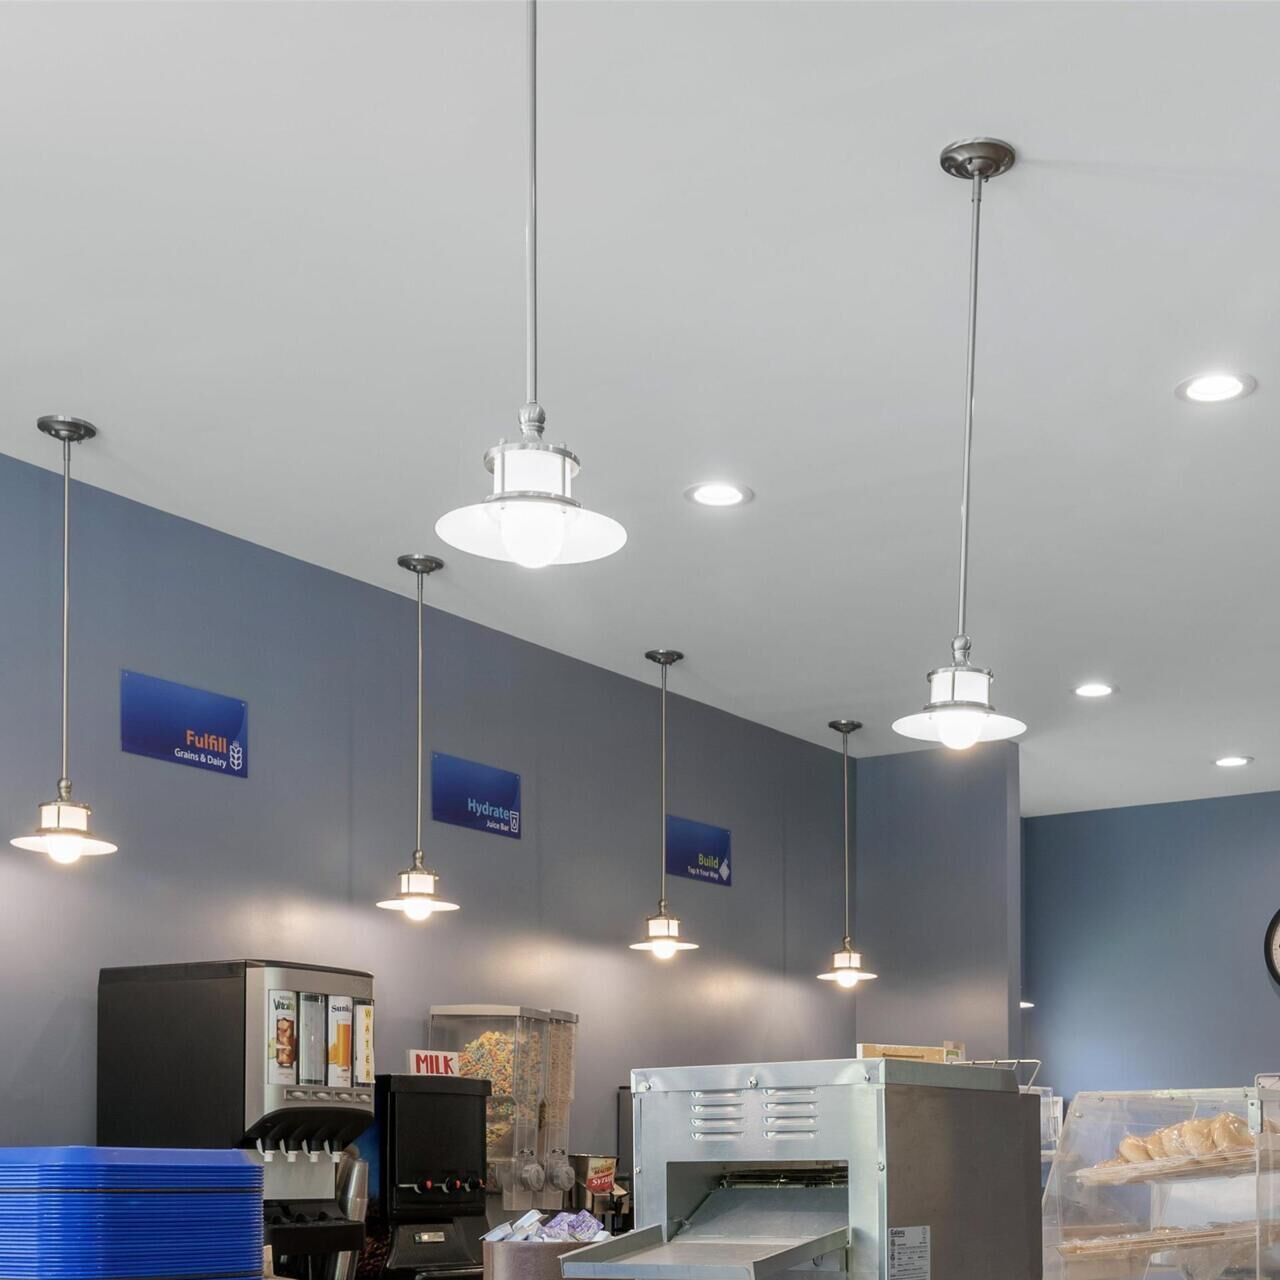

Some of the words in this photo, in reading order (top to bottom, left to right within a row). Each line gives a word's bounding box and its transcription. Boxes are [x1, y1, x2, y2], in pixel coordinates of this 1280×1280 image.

[186, 730, 227, 753] Fulfill
[174, 748, 199, 762] Grains
[200, 754, 206, 763] &
[207, 756, 227, 769] Dairy
[468, 799, 510, 820] Hydrate
[486, 820, 500, 830] Juice
[699, 854, 719, 869] Build
[364, 1008, 372, 1079] WATER
[415, 1054, 454, 1075] MILK
